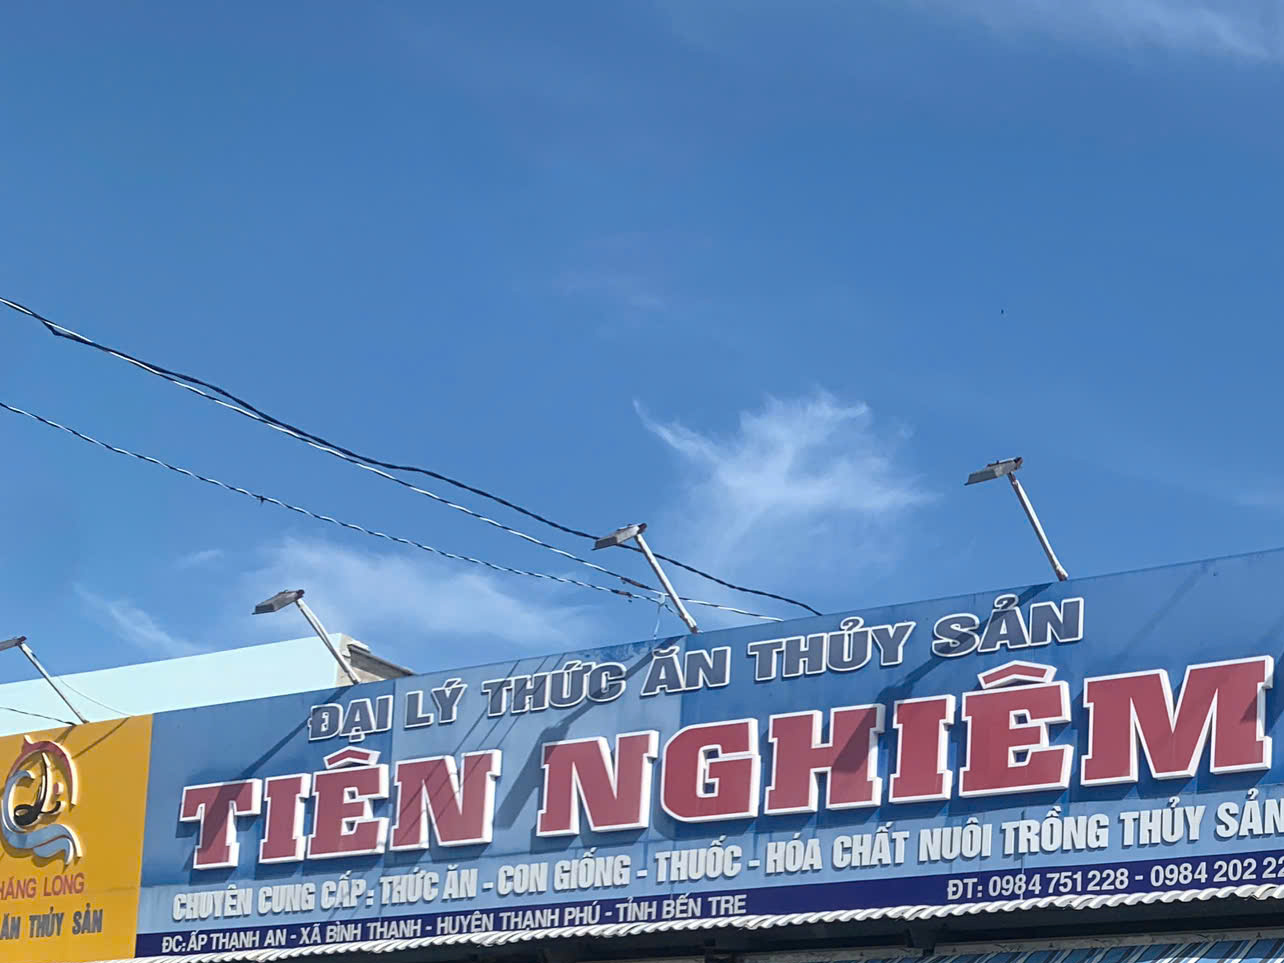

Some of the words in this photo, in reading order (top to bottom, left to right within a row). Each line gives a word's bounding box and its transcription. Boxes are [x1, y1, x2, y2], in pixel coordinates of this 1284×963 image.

[308, 695, 393, 742] ĐẠI
[404, 678, 467, 730] LÝ
[482, 660, 627, 718] THỨC
[641, 646, 732, 697] ĂN
[748, 616, 917, 681] THỦY
[931, 594, 1085, 658] SẢN
[179, 745, 502, 870] TIÊN
[536, 654, 1274, 838] NGHIÊM
[172, 884, 253, 921] CHUYÊN
[257, 882, 316, 915] CUNG
[379, 866, 440, 907] THỨC
[442, 864, 479, 901] ĂN
[497, 861, 548, 896] CON
[553, 847, 632, 891] GIỐNG
[655, 835, 743, 884] THUỐC
[765, 832, 824, 876] HÓA
[833, 821, 909, 869] CHẤT
[918, 816, 993, 863] NUÔI
[1000, 805, 1110, 856] TRỒNG
[1119, 795, 1206, 845] THỦY
[947, 877, 983, 901] ĐT:
[988, 872, 1041, 899] 0984
[1046, 871, 1083, 896] 751
[1087, 868, 1129, 892] 228
[1150, 861, 1207, 889] 0984
[1212, 858, 1257, 884] 202
[0, 876, 37, 900] HĂNG
[43, 872, 85, 896] LONG
[0, 912, 21, 940] ĂN
[29, 906, 64, 938] THỦY
[72, 902, 103, 935] SẢN
[263, 928, 287, 947] AN
[299, 921, 322, 945] XÃ
[325, 919, 362, 943] BÌNH
[367, 918, 422, 942] THẠNH
[498, 906, 558, 931] THẠNH
[563, 901, 601, 926] PHÚ
[616, 898, 658, 924] TỈNH
[661, 893, 703, 919] BẾN
[707, 893, 748, 917] TRE
